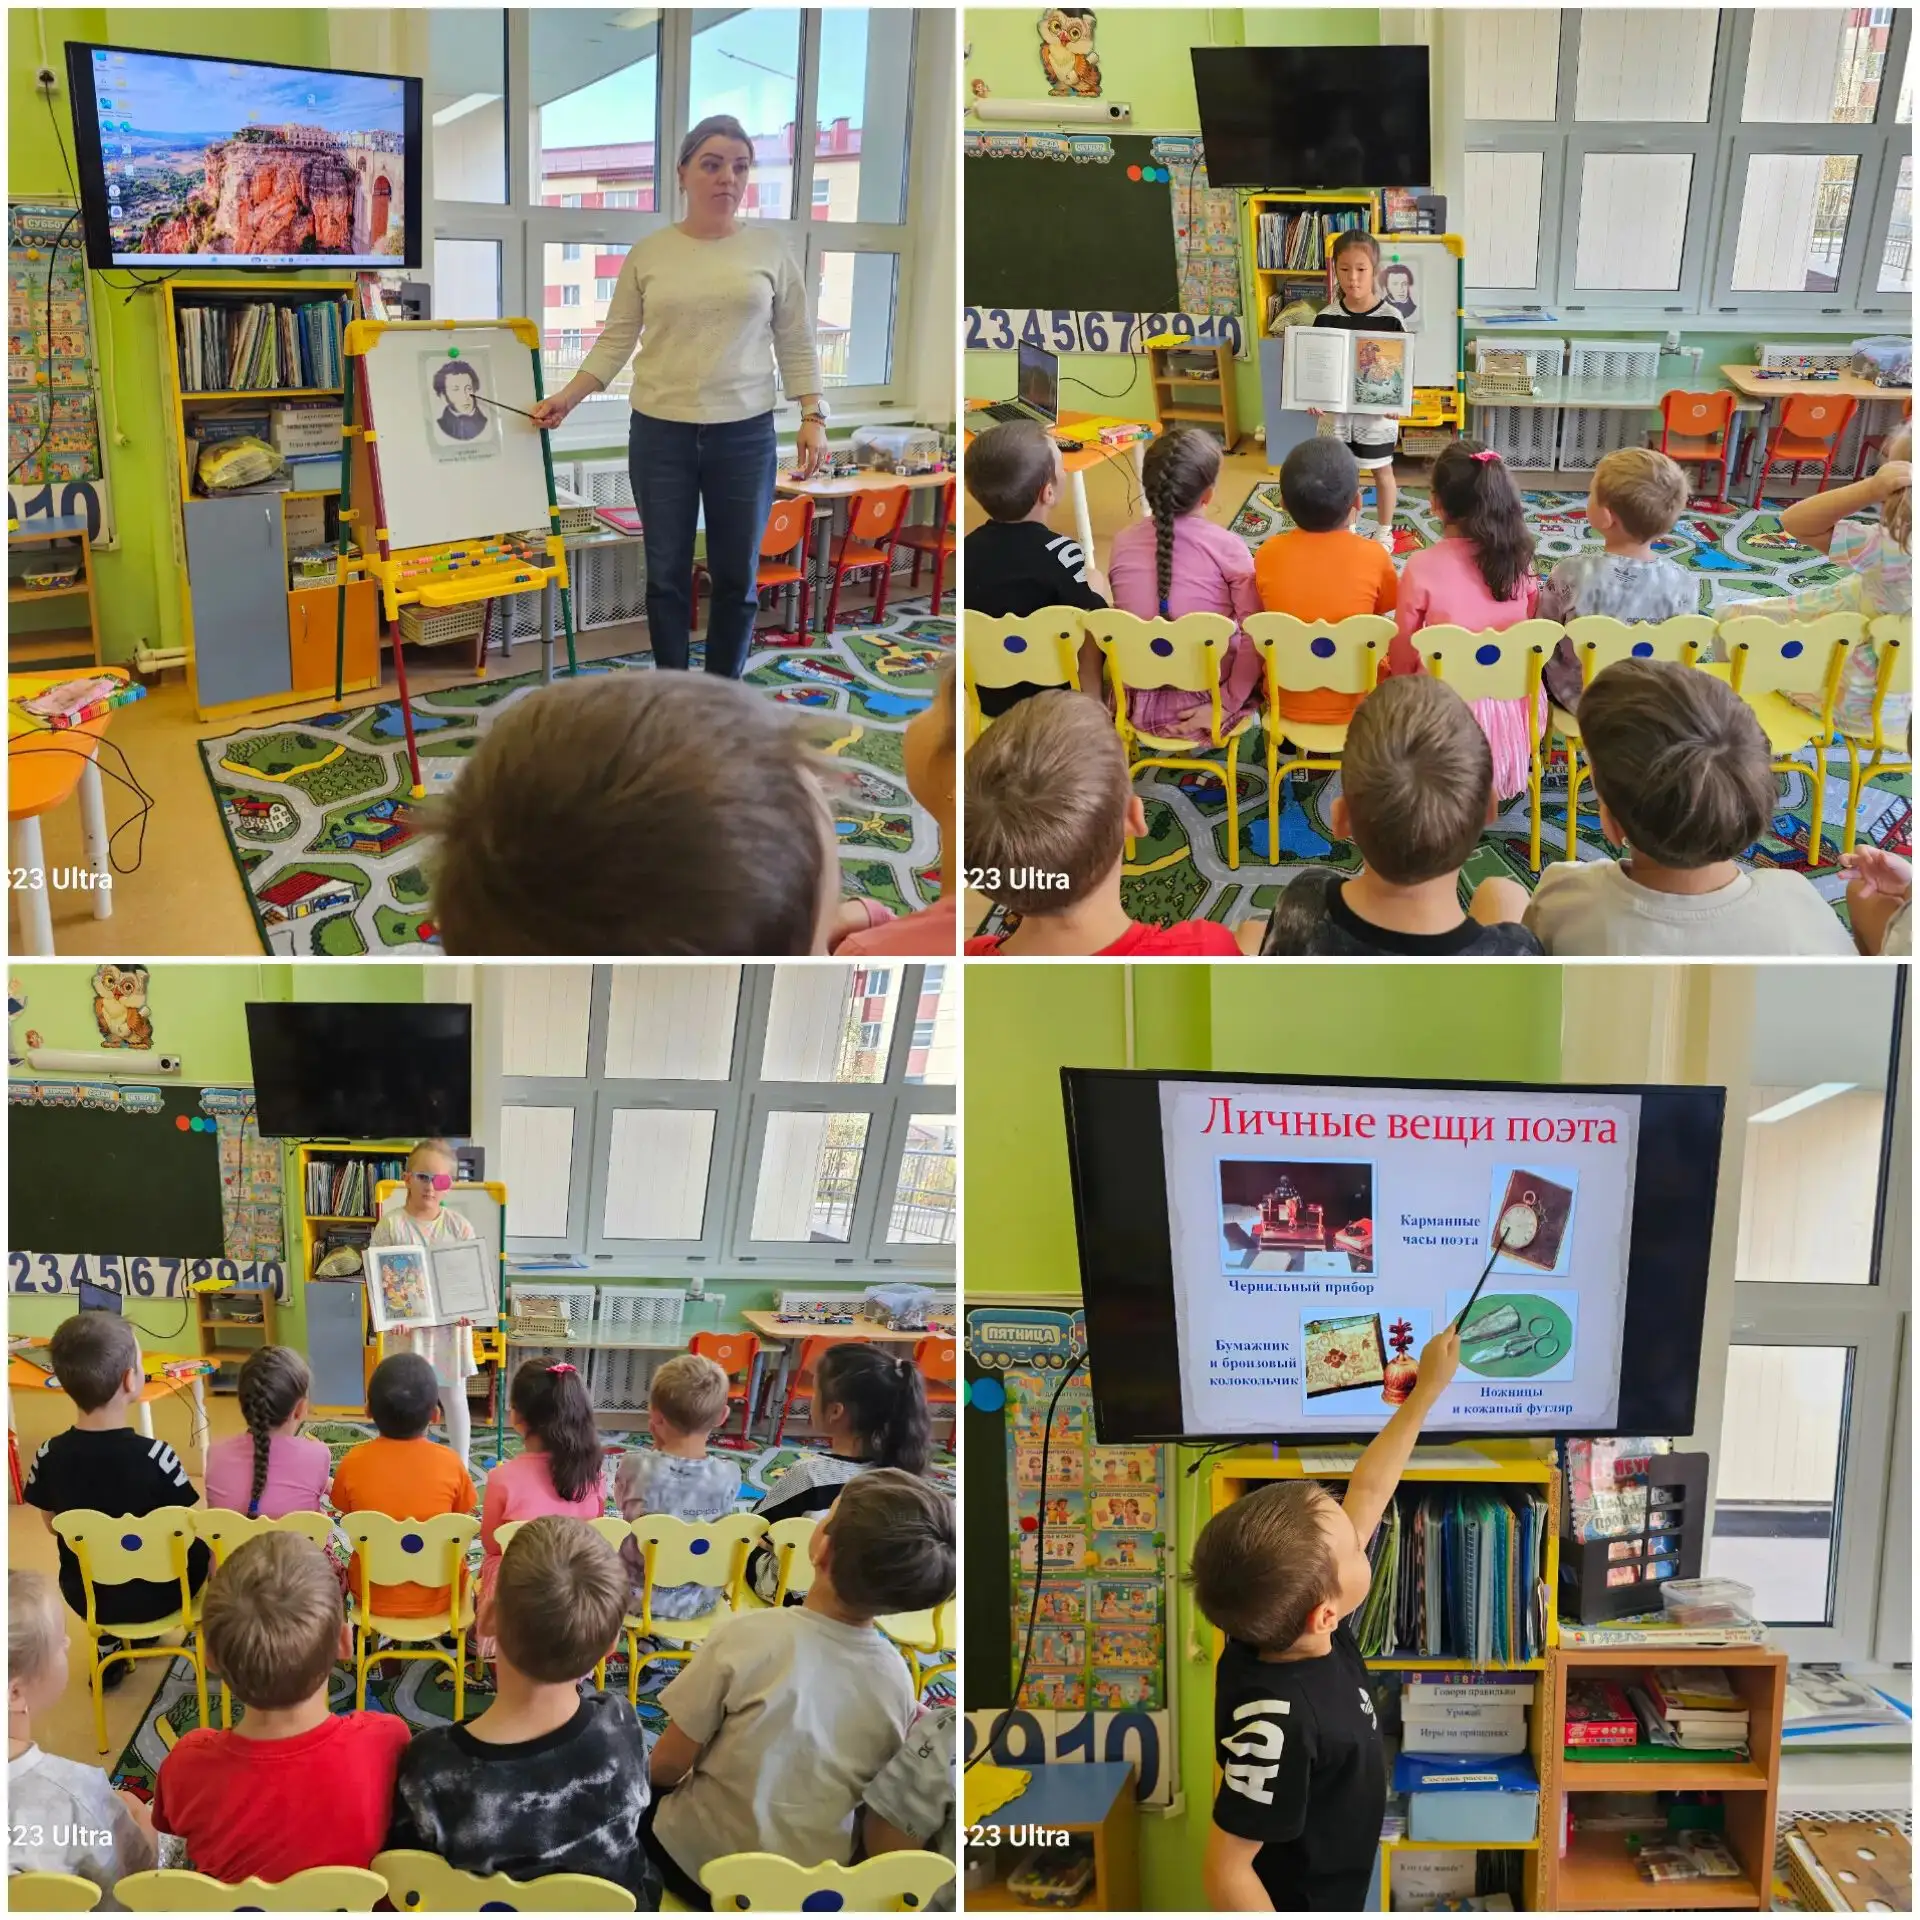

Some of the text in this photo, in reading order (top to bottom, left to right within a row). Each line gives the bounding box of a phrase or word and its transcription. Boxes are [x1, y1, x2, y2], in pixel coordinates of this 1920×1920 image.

[1200, 1097, 1618, 1149] Личные вещи поэта
[1400, 1214, 1481, 1229] Карманные
[1402, 1236, 1479, 1246] часы поэта
[1229, 1280, 1375, 1296] Чернильный прибор
[987, 1326, 1056, 1343] ПЯТНИЦА
[1215, 1339, 1290, 1354] Бумажник
[1209, 1357, 1297, 1371] и бронзовый
[1209, 1377, 1300, 1387] колокольчик
[1480, 1386, 1543, 1399] Ножницы
[1452, 1403, 1573, 1416] и кожаный футляр
[1434, 1687, 1516, 1698] Говори правильно
[1446, 1708, 1482, 1718] Урожай
[1420, 1728, 1445, 1740] Игры
[1460, 1730, 1509, 1739] прищепках
[1221, 1699, 1291, 1805] ADI
